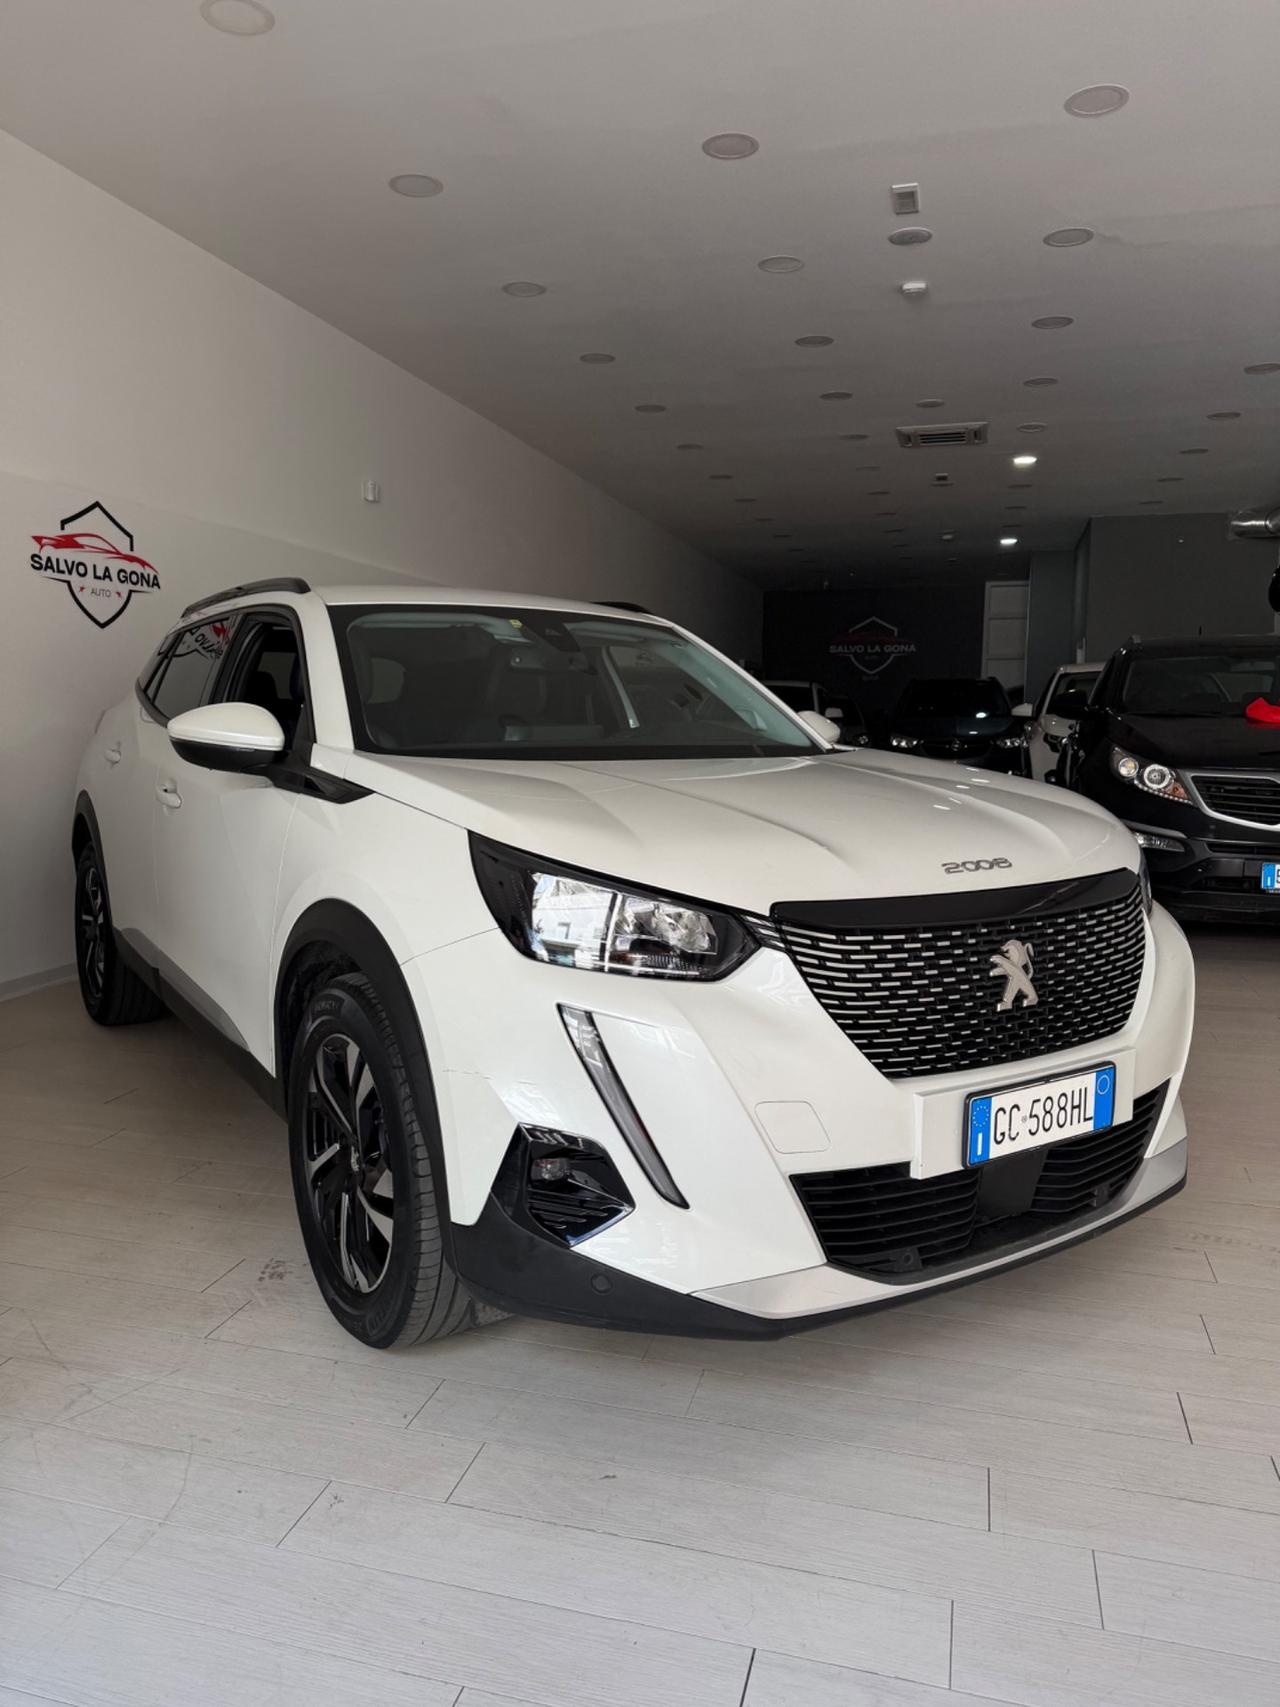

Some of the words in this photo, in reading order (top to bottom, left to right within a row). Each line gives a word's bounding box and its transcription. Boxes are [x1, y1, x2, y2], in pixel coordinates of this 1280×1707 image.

[31, 553, 88, 578] SALVO
[93, 564, 113, 582] LA
[117, 569, 161, 589] GONA
[91, 588, 112, 598] AUTO
[829, 645, 864, 653] SALVO
[867, 645, 881, 653] LA
[883, 644, 916, 653] GONA
[941, 857, 1013, 874] 2008
